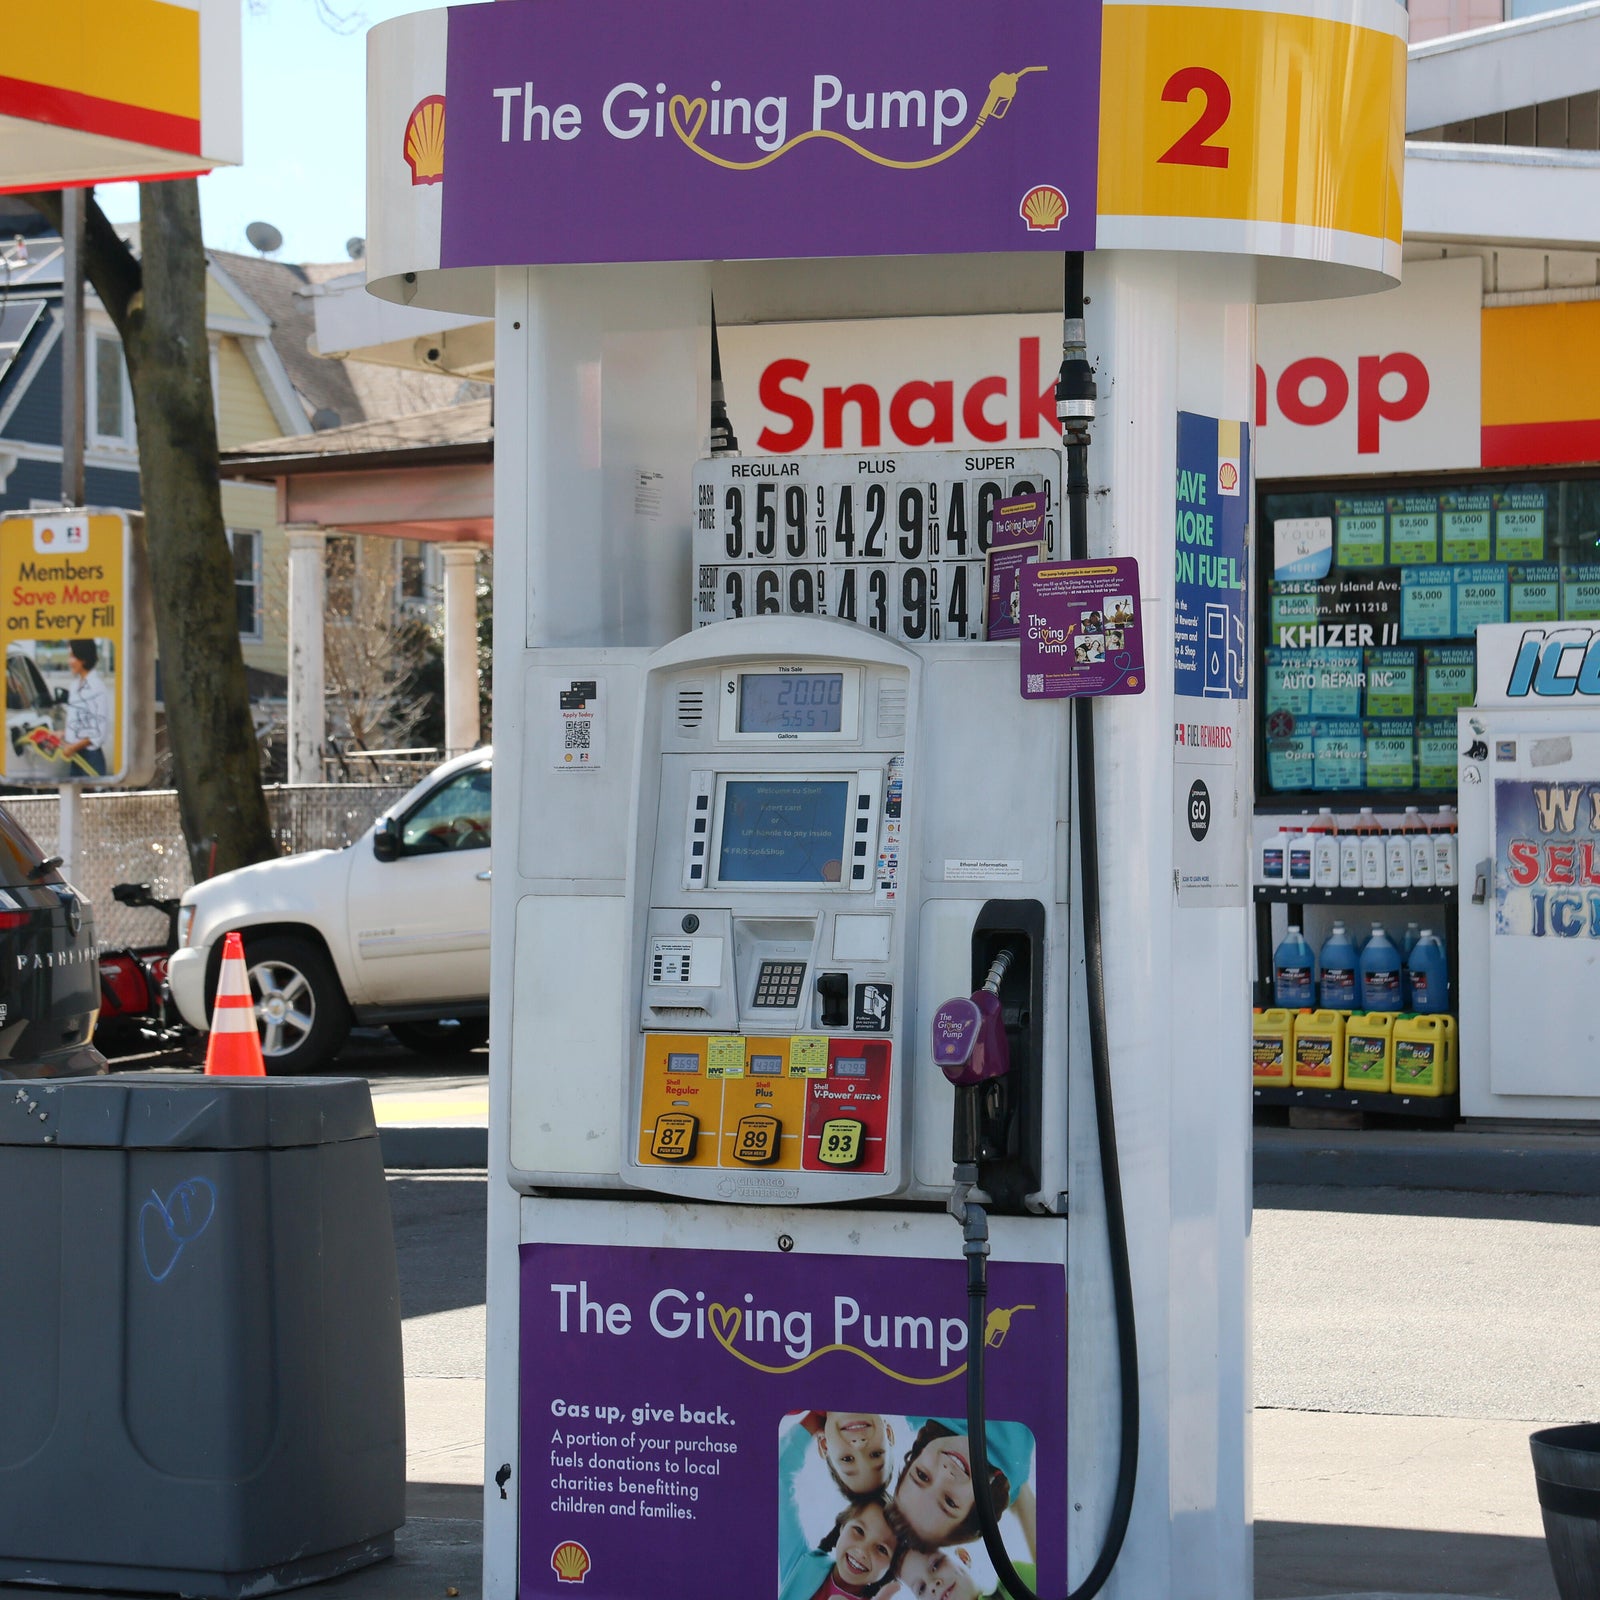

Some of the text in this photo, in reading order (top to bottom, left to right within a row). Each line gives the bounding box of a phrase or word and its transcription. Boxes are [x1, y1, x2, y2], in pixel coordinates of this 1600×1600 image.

[493, 74, 968, 152] The Giving Pump
[1156, 66, 1231, 168] 2
[757, 336, 1430, 454] Snack op
[731, 456, 1015, 477] REGULAR PLUS SUPER
[699, 485, 715, 529] CASH PRICE
[725, 483, 806, 558] 3.59
[835, 483, 923, 560] 4.29
[996, 521, 1004, 533] The
[1022, 516, 1036, 530] Pump
[1347, 521, 1376, 530] $1,000
[1399, 518, 1428, 527] $2,500
[1451, 515, 1482, 525] $5,000
[1505, 515, 1536, 524] $2,500
[1281, 530, 1326, 539] YOUR
[19, 559, 104, 582] Members
[1199, 554, 1242, 589] FUEL
[1289, 564, 1317, 573] HERE
[699, 568, 718, 588] CREDIT
[13, 585, 110, 606] Save More
[1303, 583, 1336, 594] Coney
[1340, 581, 1374, 592] Island
[1377, 581, 1401, 591] Ave.
[1411, 591, 1442, 600] $5,000
[1465, 589, 1496, 597] $2,000
[1523, 588, 1546, 597] $500
[1577, 587, 1600, 596] $500
[699, 592, 715, 612] PRICE
[1280, 602, 1388, 615] Brooklyn, NY 11218
[7, 606, 115, 634] on Every Fill
[1028, 614, 1046, 627] The
[1028, 627, 1063, 642] Giving
[1279, 624, 1374, 648] KHIZER
[1039, 643, 1067, 656] Pump
[1506, 628, 1600, 697] IC
[1282, 672, 1393, 689] AUTO REPAIR INC
[1435, 669, 1466, 678] $5,000
[727, 681, 735, 694] $
[1187, 725, 1232, 748] FUEL REWARDS
[1374, 741, 1405, 750] $5,000
[1285, 750, 1368, 761] Open 24 Hours
[1191, 800, 1207, 820] GO
[1532, 784, 1600, 834] W
[1506, 840, 1600, 888] SEL
[1530, 889, 1600, 938] IC
[938, 1020, 962, 1030] Giving
[939, 1013, 952, 1021] The
[942, 1030, 963, 1040] Pump
[1412, 1050, 1430, 1059] 500
[665, 1086, 699, 1097] Regular
[755, 1088, 773, 1097] Plus
[814, 1091, 852, 1099] V-Power
[661, 1129, 685, 1146] 87
[743, 1131, 767, 1148] 89
[828, 1135, 852, 1152] 93
[551, 1281, 968, 1366] The Giving Pump
[551, 1399, 736, 1427] Gas up, give back.
[551, 1431, 738, 1456] A portion of your purchase
[551, 1451, 720, 1476] fuels donations to local
[551, 1474, 699, 1500] charities benefitting
[551, 1497, 697, 1521] children and families.
